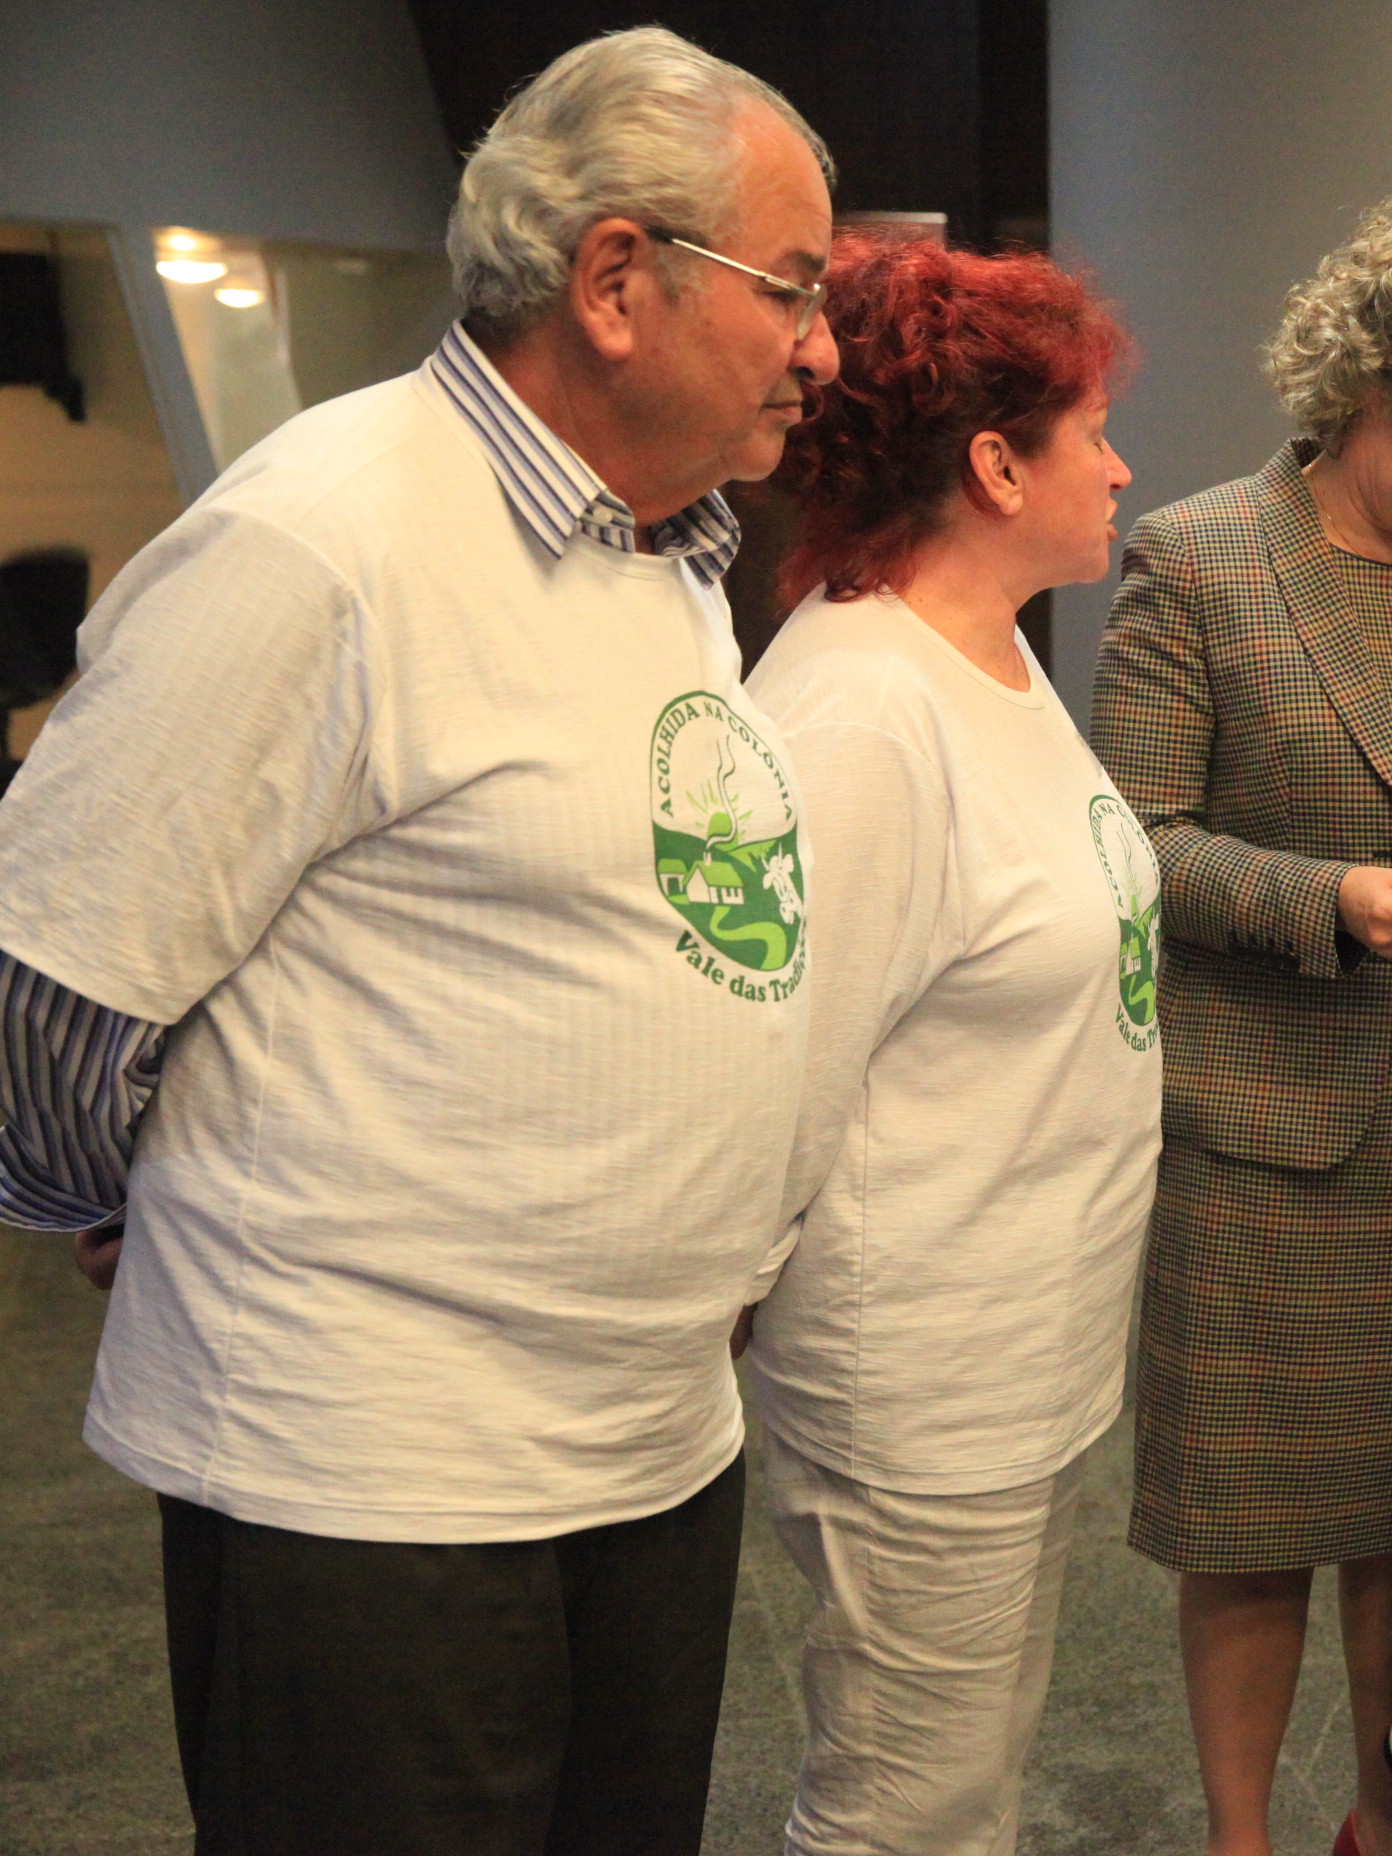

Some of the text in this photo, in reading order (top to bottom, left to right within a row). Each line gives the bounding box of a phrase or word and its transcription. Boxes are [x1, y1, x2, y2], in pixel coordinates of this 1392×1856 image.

[657, 700, 793, 821] ACOLHIDA NA COLÔNIA
[675, 929, 726, 986] Vale
[728, 972, 768, 1003] das
[1115, 1003, 1147, 1052] Vale das
